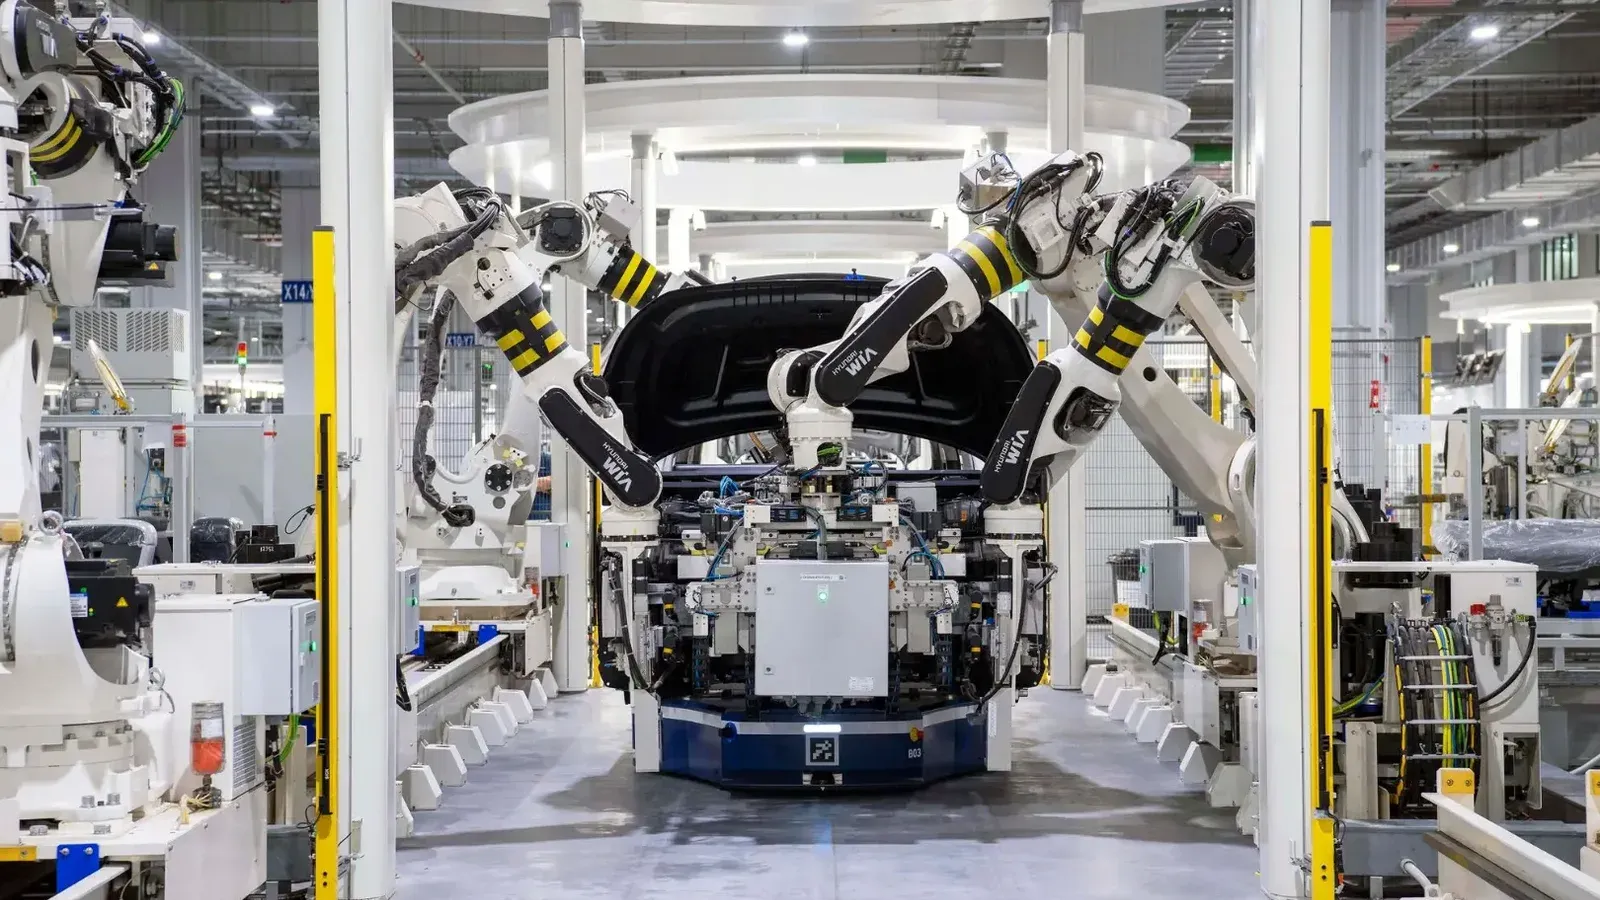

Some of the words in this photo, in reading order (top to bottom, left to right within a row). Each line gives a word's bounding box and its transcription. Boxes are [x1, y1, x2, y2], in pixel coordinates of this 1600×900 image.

[832, 350, 858, 376] HYUNDAI
[602, 442, 629, 470] HYUNDAI
[994, 440, 1010, 472] HYUNDAI
[908, 748, 921, 758] B03
